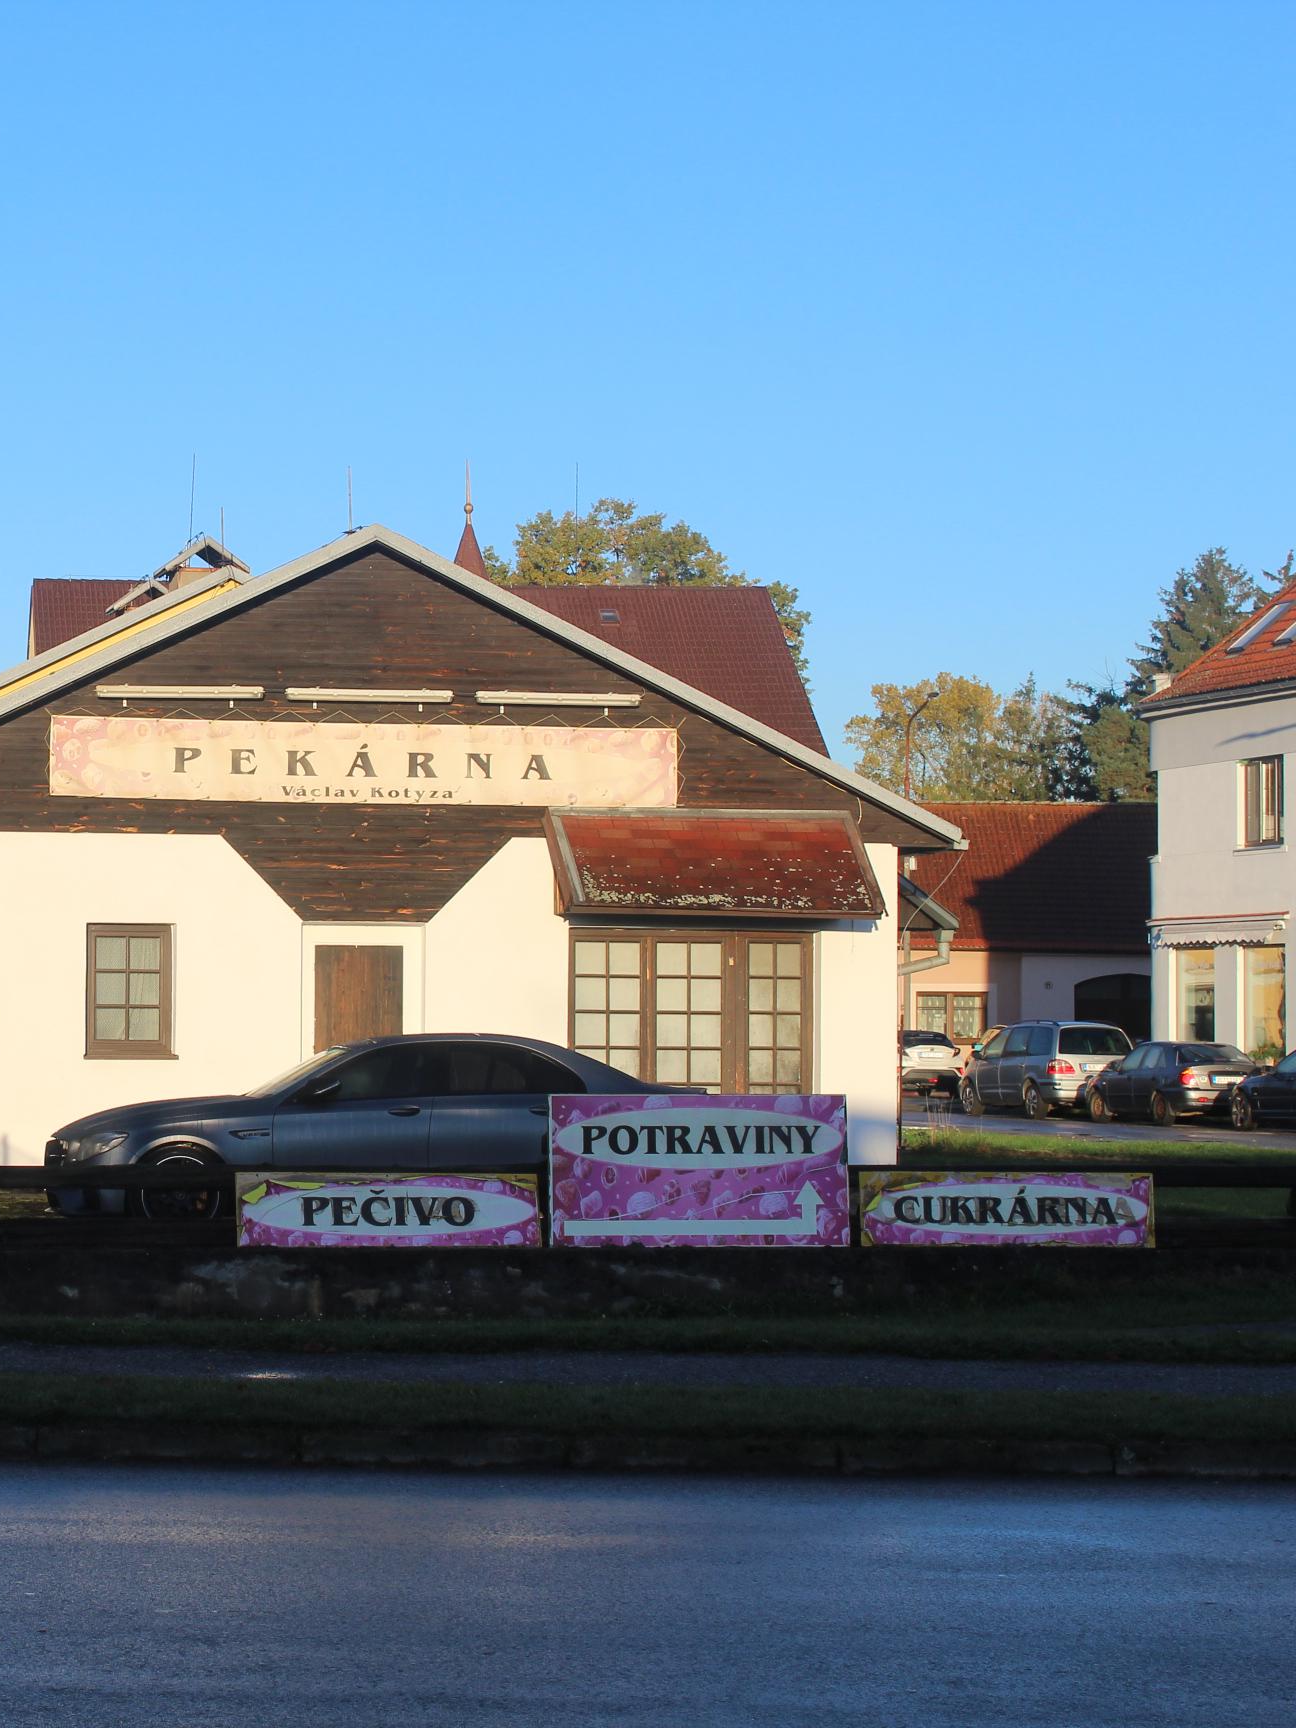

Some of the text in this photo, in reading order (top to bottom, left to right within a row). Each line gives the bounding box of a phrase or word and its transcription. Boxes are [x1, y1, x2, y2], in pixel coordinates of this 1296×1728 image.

[172, 743, 553, 781] PEKÁRNA
[280, 785, 454, 801] Václav Kotyza
[580, 1124, 822, 1155] POTRAVINY
[300, 1189, 477, 1227] PEČIVO
[893, 1185, 1119, 1226] CUKRÁRNA
